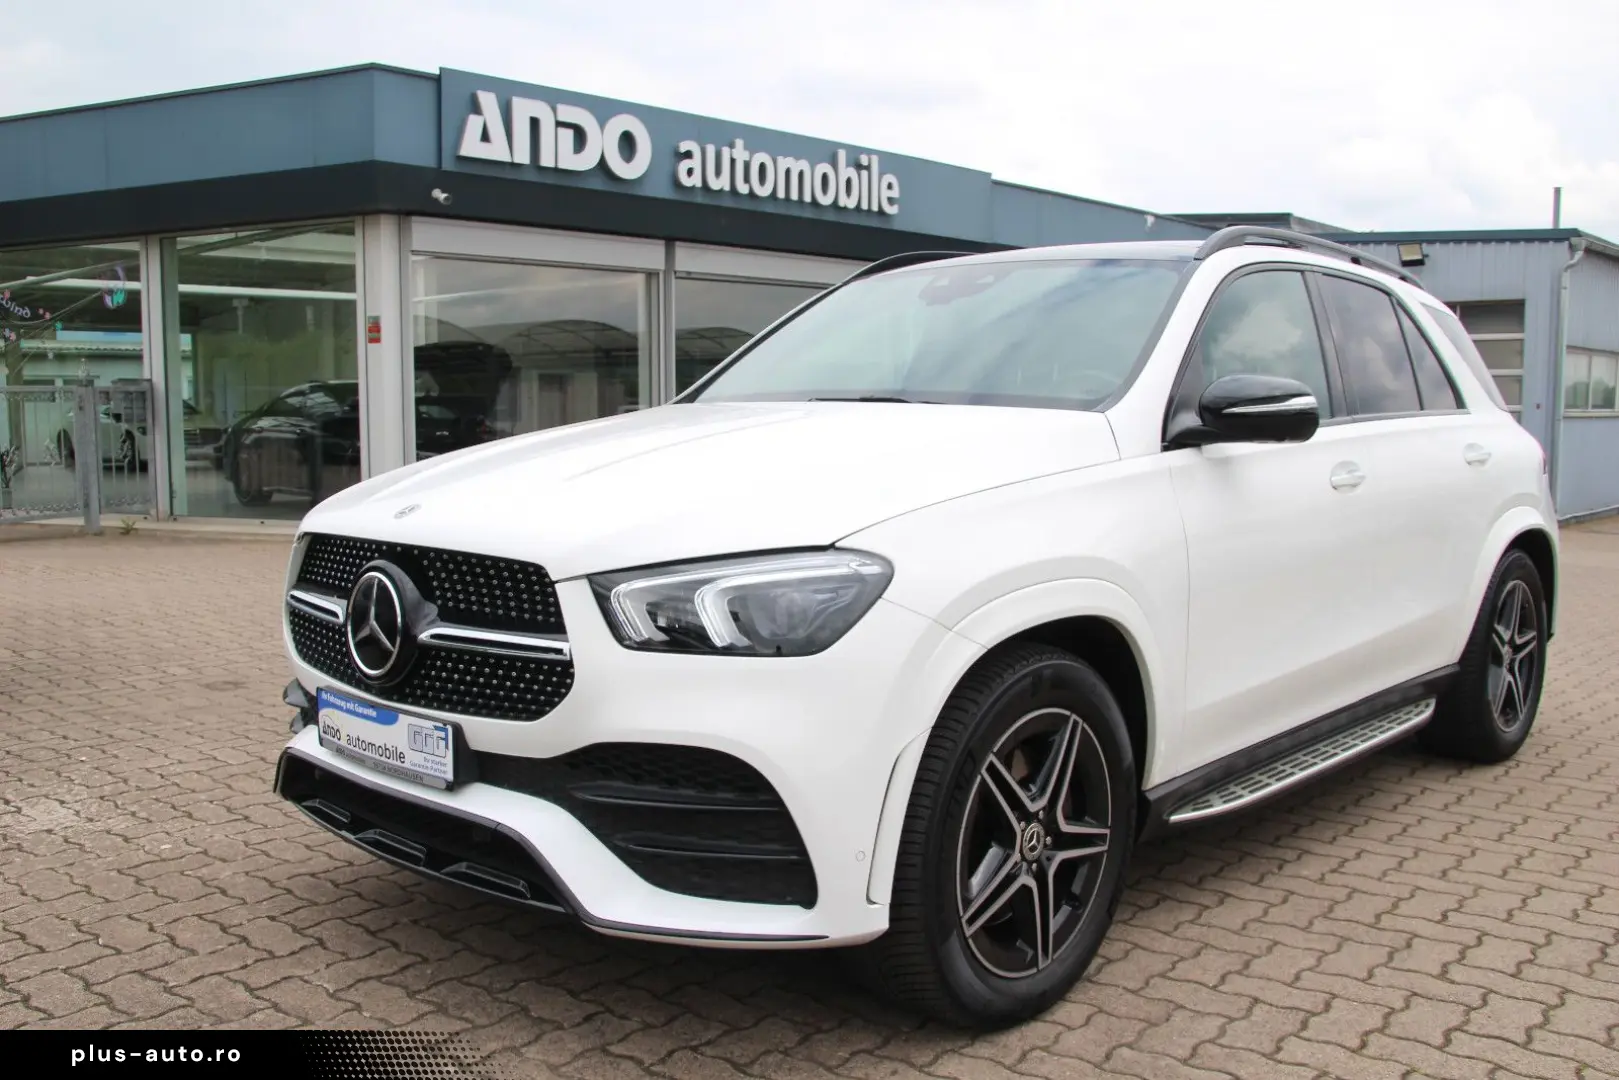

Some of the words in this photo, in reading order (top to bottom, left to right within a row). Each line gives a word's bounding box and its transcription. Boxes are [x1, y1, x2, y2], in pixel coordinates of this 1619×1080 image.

[457, 90, 652, 180] ANDO
[675, 138, 900, 215] automobile
[346, 701, 355, 711] mit
[355, 703, 377, 718] Garantie
[346, 733, 406, 764] automobile
